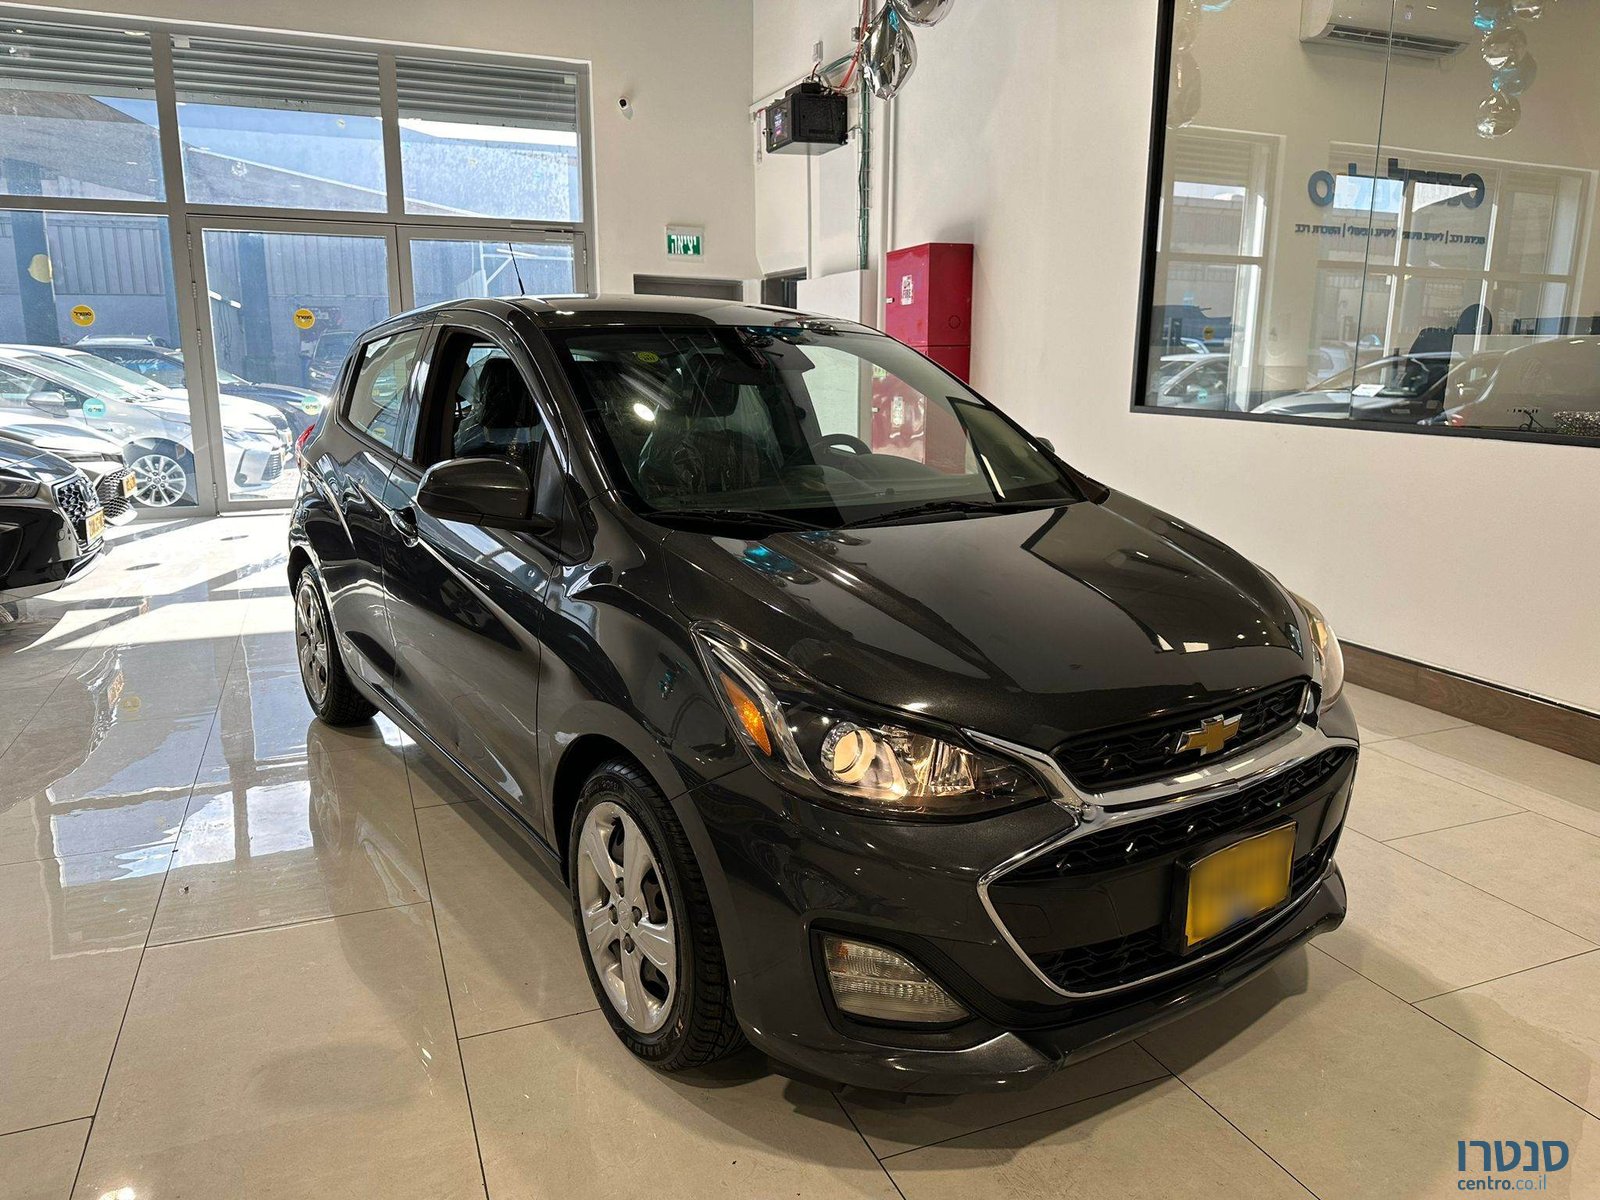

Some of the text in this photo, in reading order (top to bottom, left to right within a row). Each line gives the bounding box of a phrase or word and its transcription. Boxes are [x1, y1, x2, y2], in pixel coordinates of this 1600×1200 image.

[1295, 223, 1310, 233] רכב
[1449, 234, 1463, 243] רכב
[671, 235, 696, 254] יציאה
